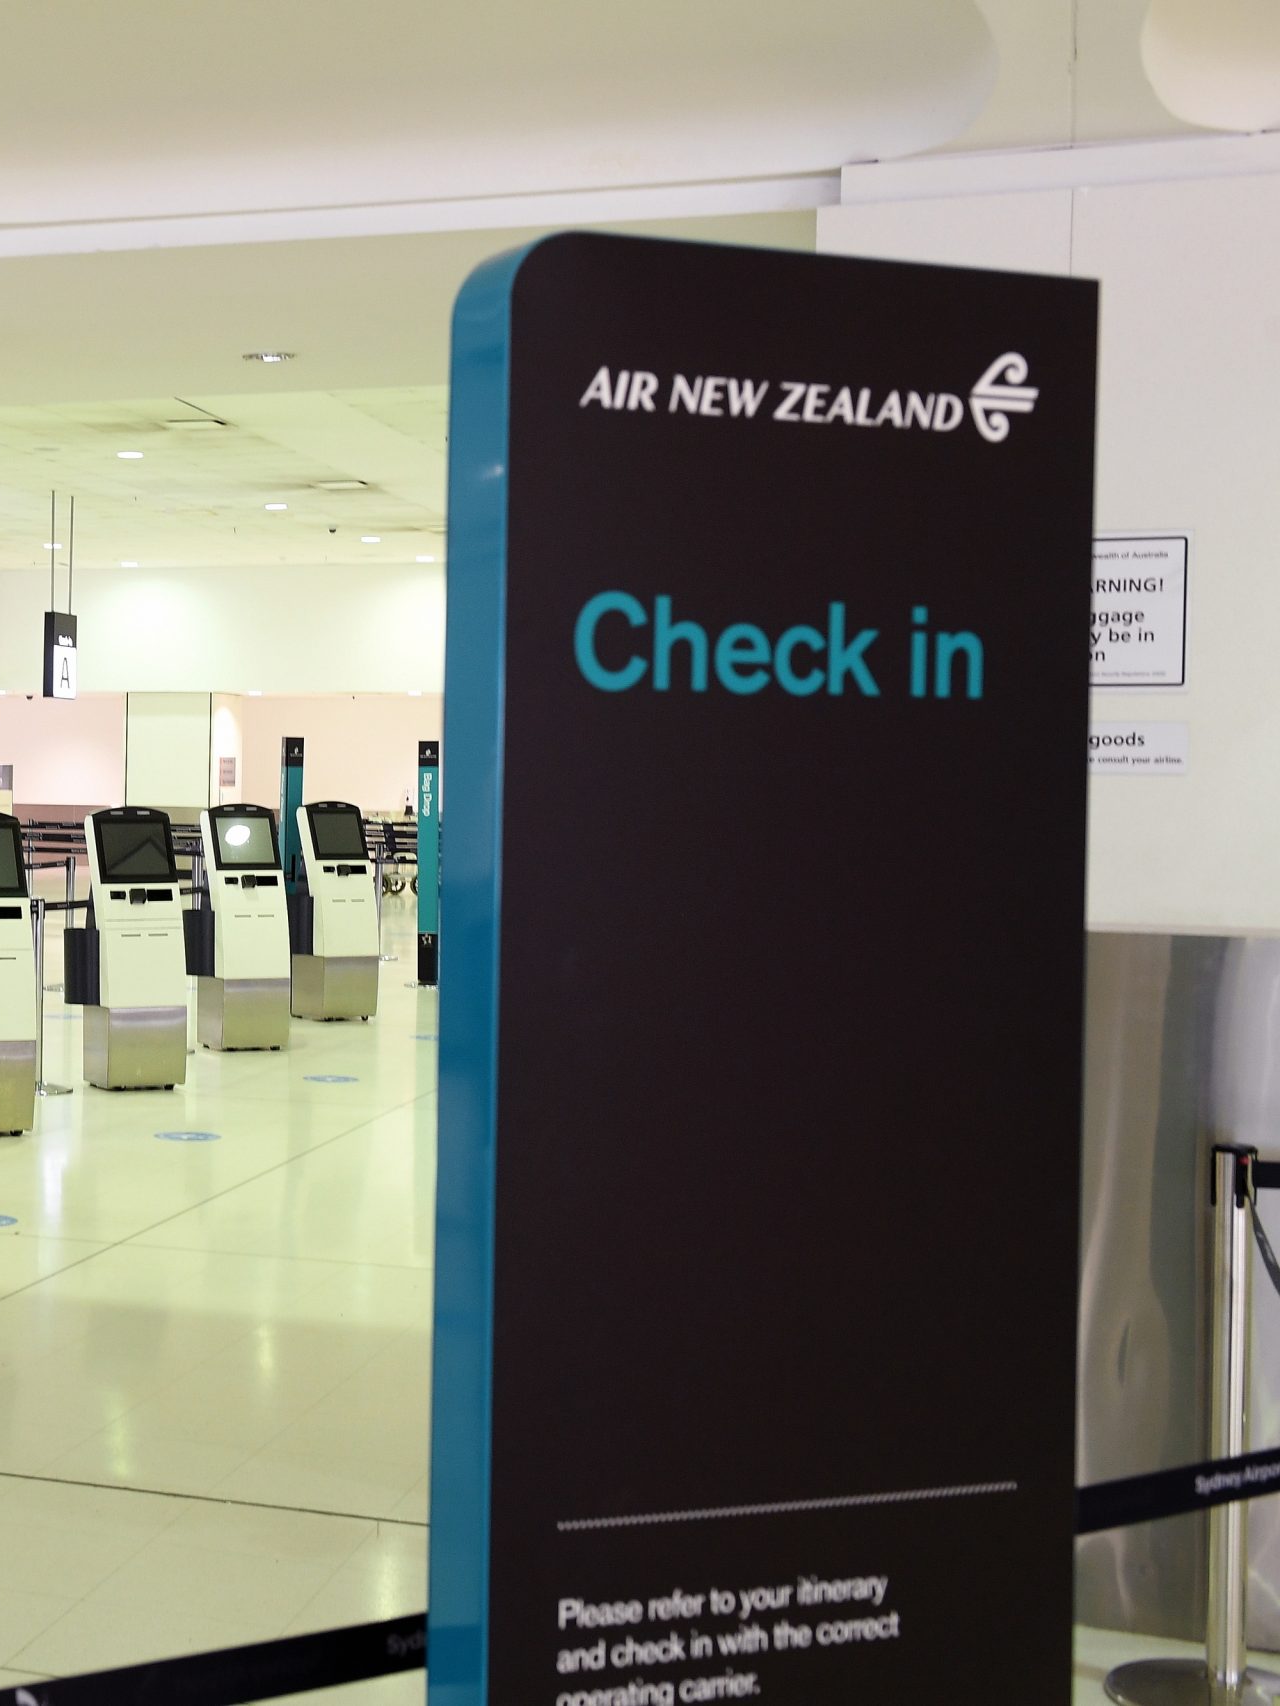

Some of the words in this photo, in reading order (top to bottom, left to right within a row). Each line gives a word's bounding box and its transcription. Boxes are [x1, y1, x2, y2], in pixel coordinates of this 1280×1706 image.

[578, 366, 658, 411] AIR
[669, 374, 768, 418] NEW
[773, 381, 965, 431] ZEALAND
[1132, 551, 1168, 559] Australia
[1090, 577, 1164, 593] RNING!
[573, 589, 880, 696] Check
[910, 605, 984, 698] in
[1109, 627, 1131, 643] be
[1138, 628, 1155, 642] in
[60, 657, 70, 688] A
[1088, 732, 1145, 750] goods
[1098, 755, 1129, 763] consult
[421, 772, 433, 792] Bag
[422, 794, 432, 816] Drop
[1194, 1471, 1241, 1495] Sydney
[558, 1597, 644, 1630] Please
[647, 1588, 707, 1622] refer
[710, 1587, 736, 1615] to
[739, 1585, 794, 1620] your
[797, 1574, 889, 1606] itinerary
[557, 1637, 606, 1674] and
[610, 1628, 686, 1668] check
[690, 1629, 713, 1658] in
[717, 1622, 768, 1656] with
[773, 1619, 813, 1650] the
[816, 1610, 900, 1646] correct
[556, 1678, 674, 1706] operating
[679, 1667, 762, 1704] carrier.
